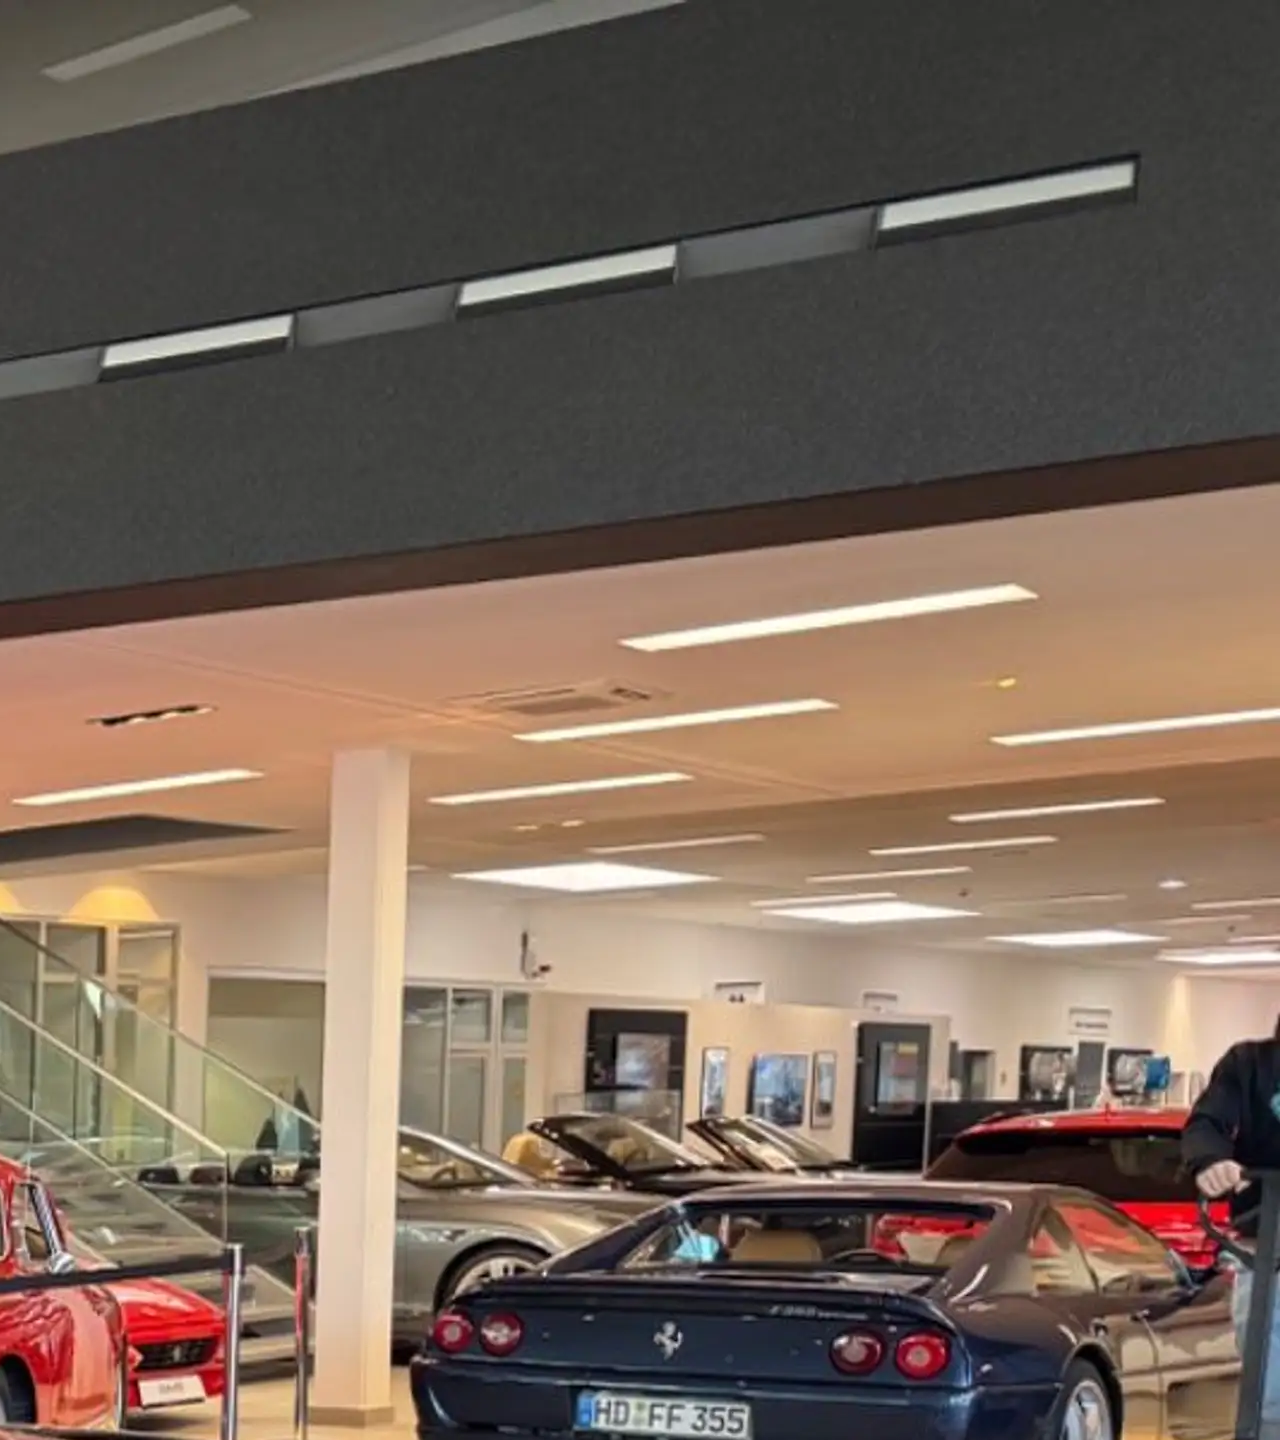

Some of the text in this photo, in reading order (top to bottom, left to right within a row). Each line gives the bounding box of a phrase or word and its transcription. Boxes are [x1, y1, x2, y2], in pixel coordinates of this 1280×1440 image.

[595, 1400, 746, 1434] HD FF 355
